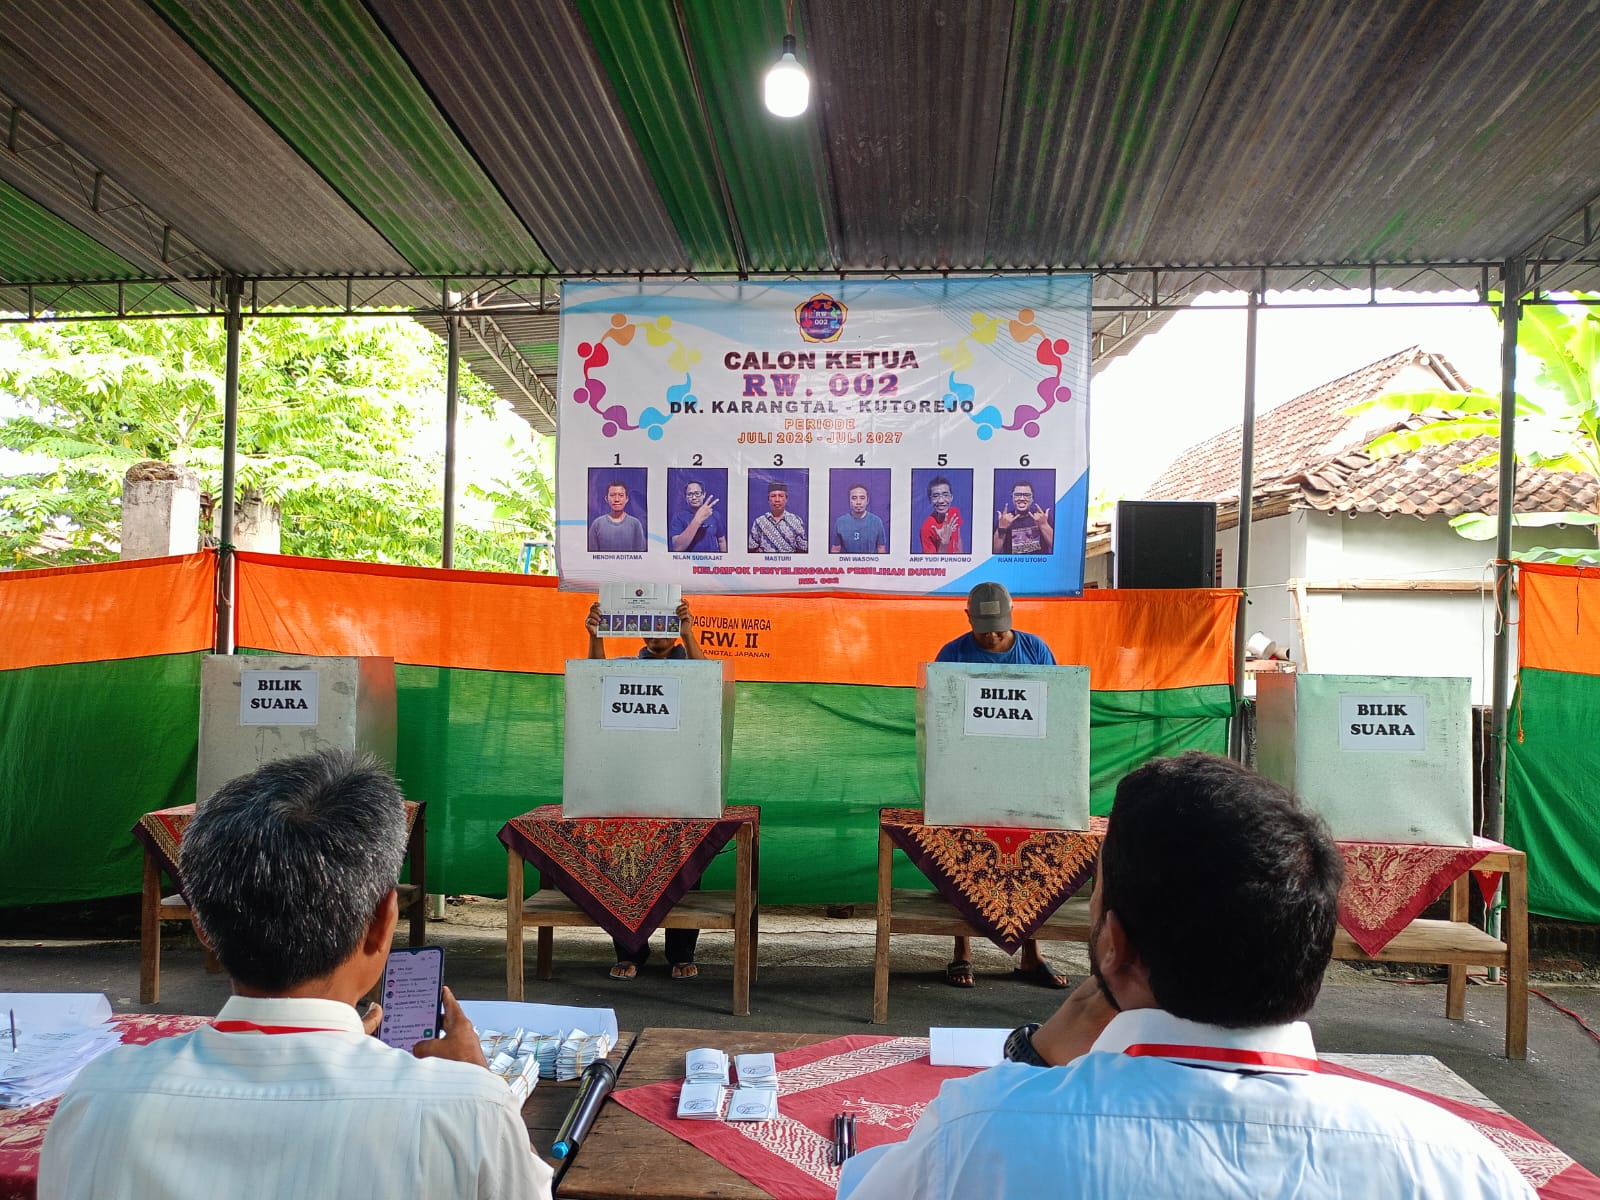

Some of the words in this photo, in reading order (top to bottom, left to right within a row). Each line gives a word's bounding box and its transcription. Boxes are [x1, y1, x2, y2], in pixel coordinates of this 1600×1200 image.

[724, 351, 816, 370] CALON
[825, 350, 919, 370] KETUA
[742, 373, 814, 397] RW.
[828, 372, 899, 397] 002
[670, 400, 704, 414] DK.
[712, 400, 838, 414] KARANGTAL
[859, 400, 974, 414] KUTOREJO
[784, 418, 856, 430] PERIODE
[737, 432, 773, 444] JULI
[776, 432, 813, 444] 2024
[826, 432, 862, 444] JULI
[866, 432, 903, 444] 2027
[614, 453, 622, 466] 1
[692, 454, 703, 466] 2
[773, 454, 784, 466] 3
[854, 454, 866, 466] 4
[938, 454, 948, 466] 5
[1019, 454, 1030, 467] 6
[692, 566, 751, 574] KELOMPOK
[752, 566, 845, 575] PENYELENGGARA
[846, 566, 906, 576] PEMILIHAN
[742, 618, 772, 631] WARGA
[700, 630, 738, 648] RW.
[744, 632, 758, 648] II
[258, 680, 302, 691] BILIK
[618, 684, 664, 696] BILIK
[980, 688, 1027, 700] BILIK
[250, 698, 308, 710] SUARA
[612, 702, 670, 714] SUARA
[1356, 704, 1408, 716] BILIK
[972, 706, 1034, 720] SUARA
[1350, 724, 1416, 736] SUARA
